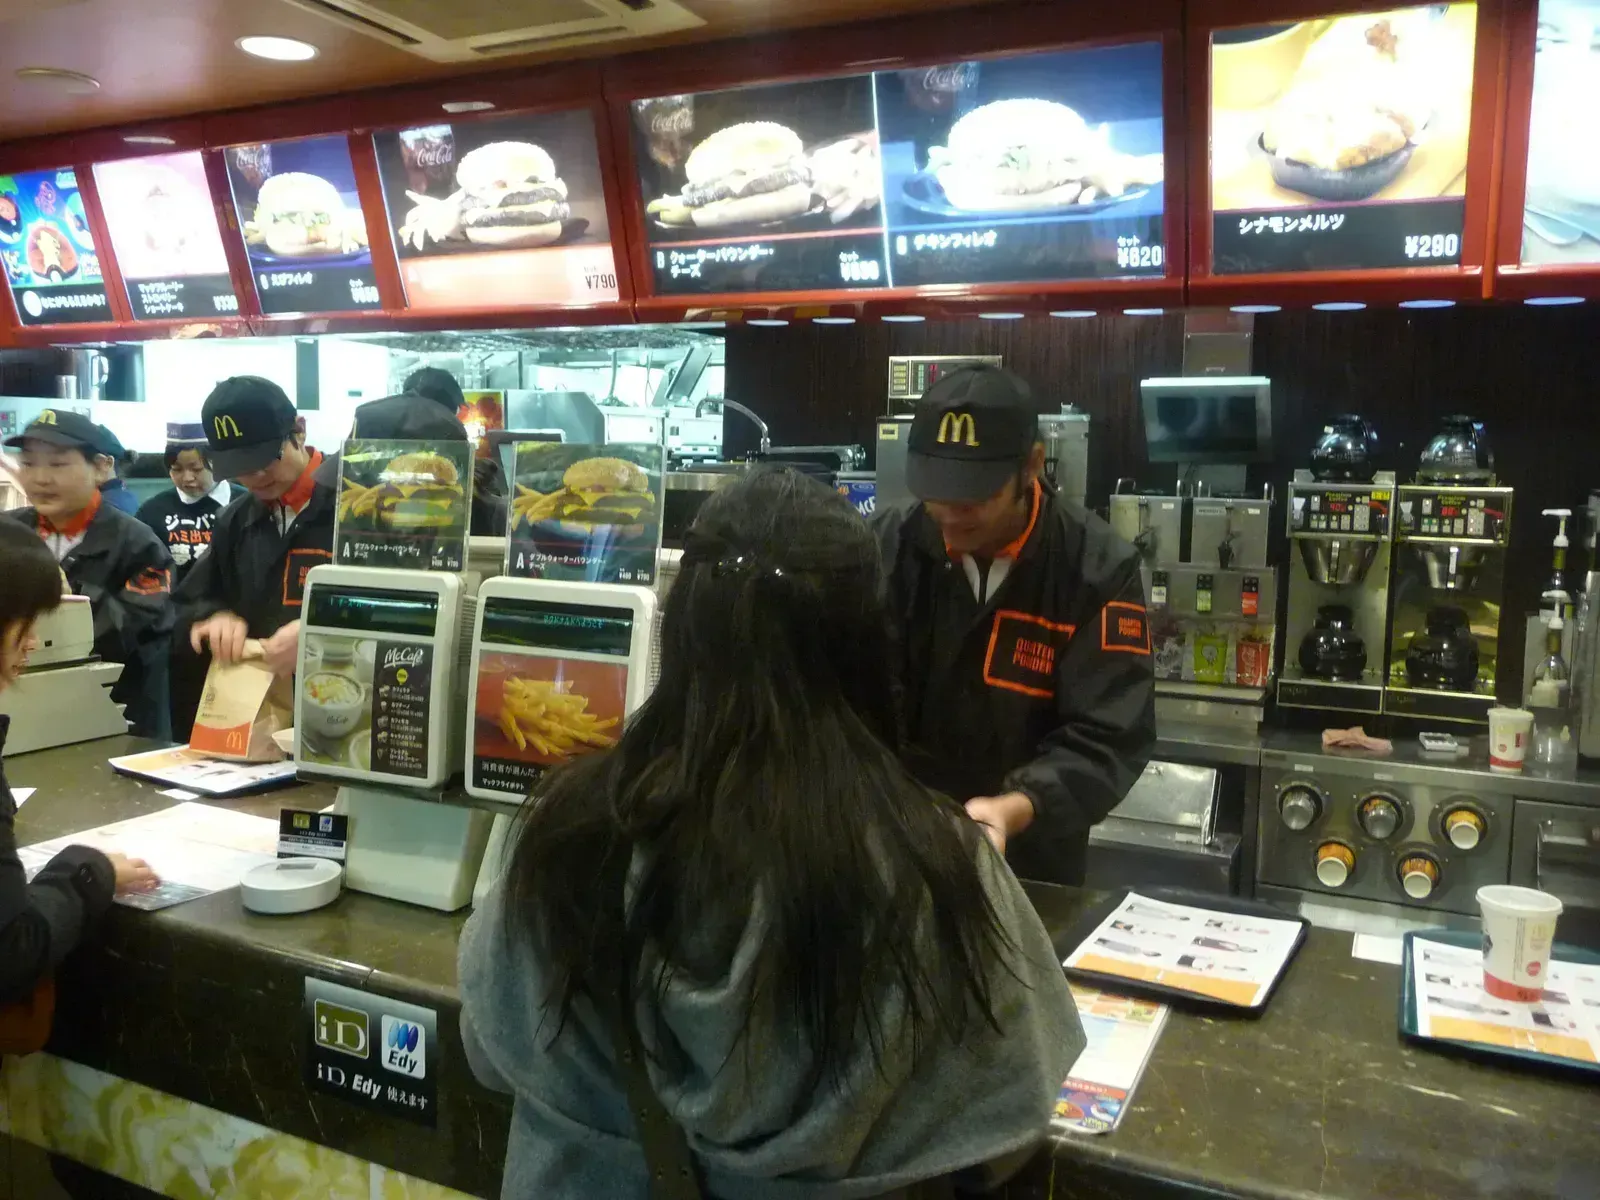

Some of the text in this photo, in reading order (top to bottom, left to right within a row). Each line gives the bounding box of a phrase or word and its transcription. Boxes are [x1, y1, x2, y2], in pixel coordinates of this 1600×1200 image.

[1239, 213, 1345, 235] シナモンメルツ
[914, 230, 997, 250] チキンフィレオ
[671, 263, 701, 278] チーズ
[585, 274, 616, 289] ¥790
[516, 552, 524, 569] A
[529, 562, 545, 570] チーズ
[318, 1014, 366, 1052] iD
[388, 1049, 418, 1074] Edy
[316, 1062, 428, 1111] iD Edy 使えます
